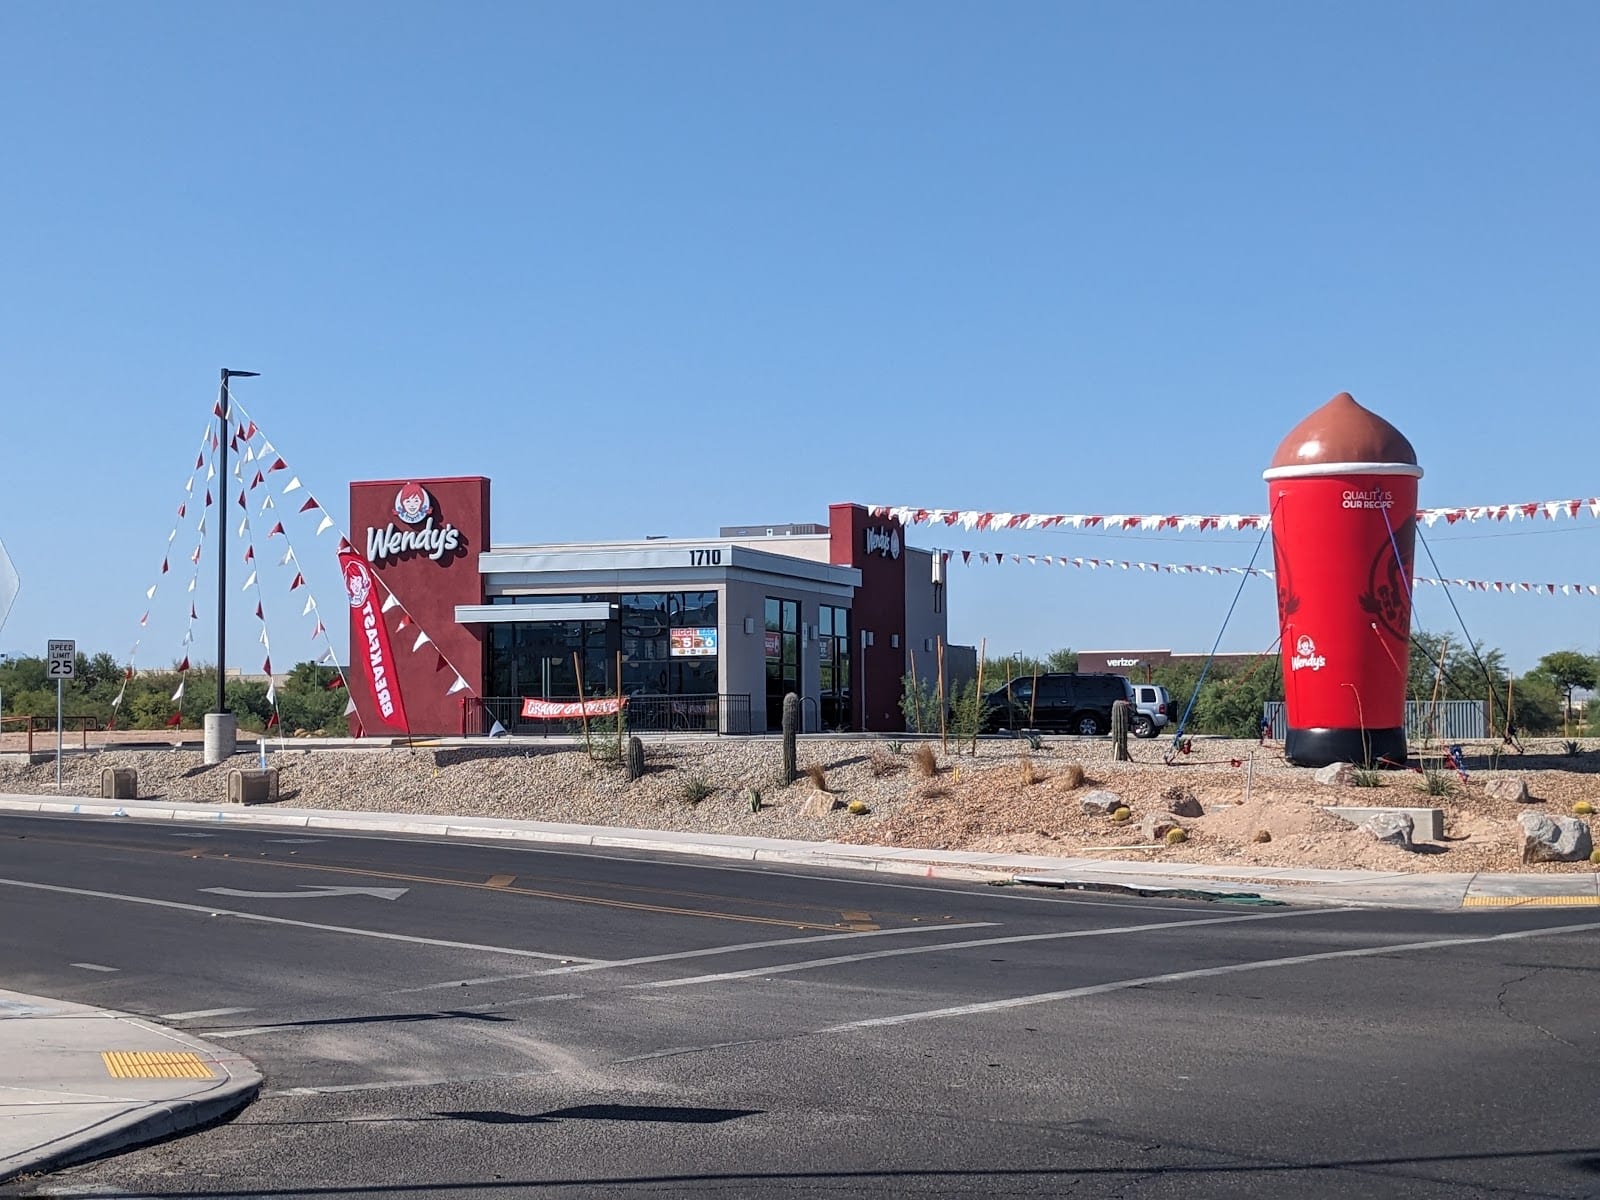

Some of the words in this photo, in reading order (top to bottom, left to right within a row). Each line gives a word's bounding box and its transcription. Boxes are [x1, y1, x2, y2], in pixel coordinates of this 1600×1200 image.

[1385, 491, 1392, 500] IS
[1342, 500, 1363, 509] OUR
[366, 517, 460, 562] Wendy's
[866, 525, 890, 557] Wendy's
[689, 549, 721, 566] 1710
[682, 637, 692, 647] 5
[705, 637, 714, 647] 6
[50, 660, 73, 674] 25
[1291, 652, 1326, 671] Wendy's
[527, 701, 564, 715] GRAND
